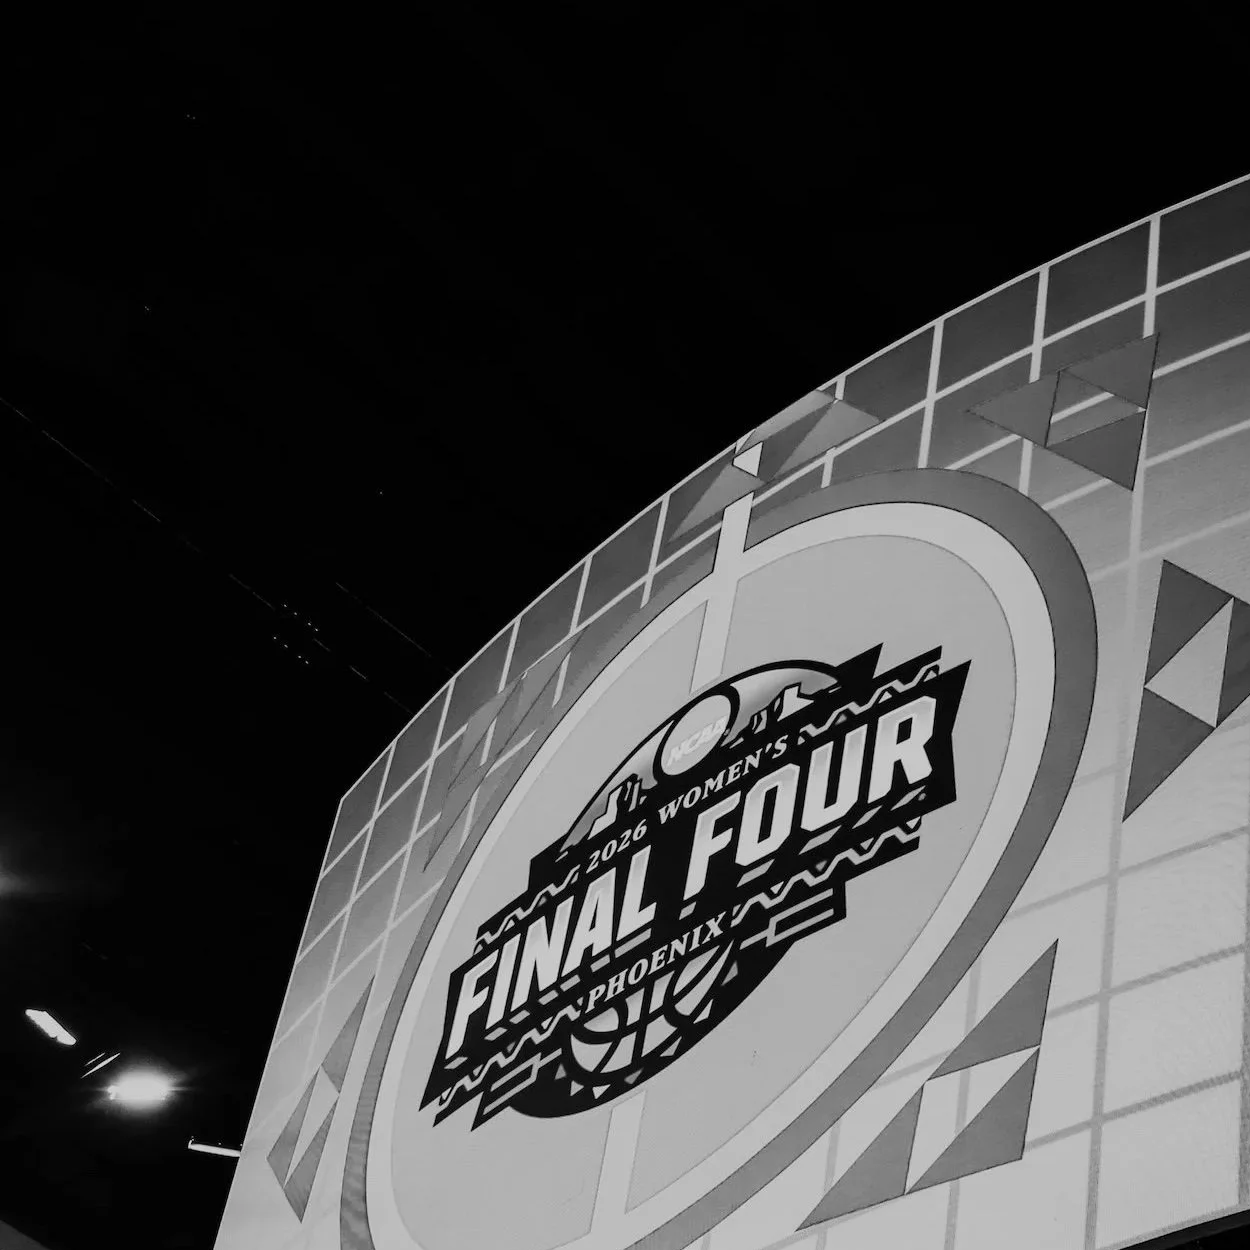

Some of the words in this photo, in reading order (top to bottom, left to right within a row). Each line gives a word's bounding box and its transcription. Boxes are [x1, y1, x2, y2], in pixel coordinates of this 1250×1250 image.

[586, 823, 648, 874] 2026
[658, 735, 789, 822] WOMEN'S
[444, 844, 657, 1060] FINAL
[683, 695, 937, 901] FOUR
[585, 910, 727, 1015] PHOENIX
